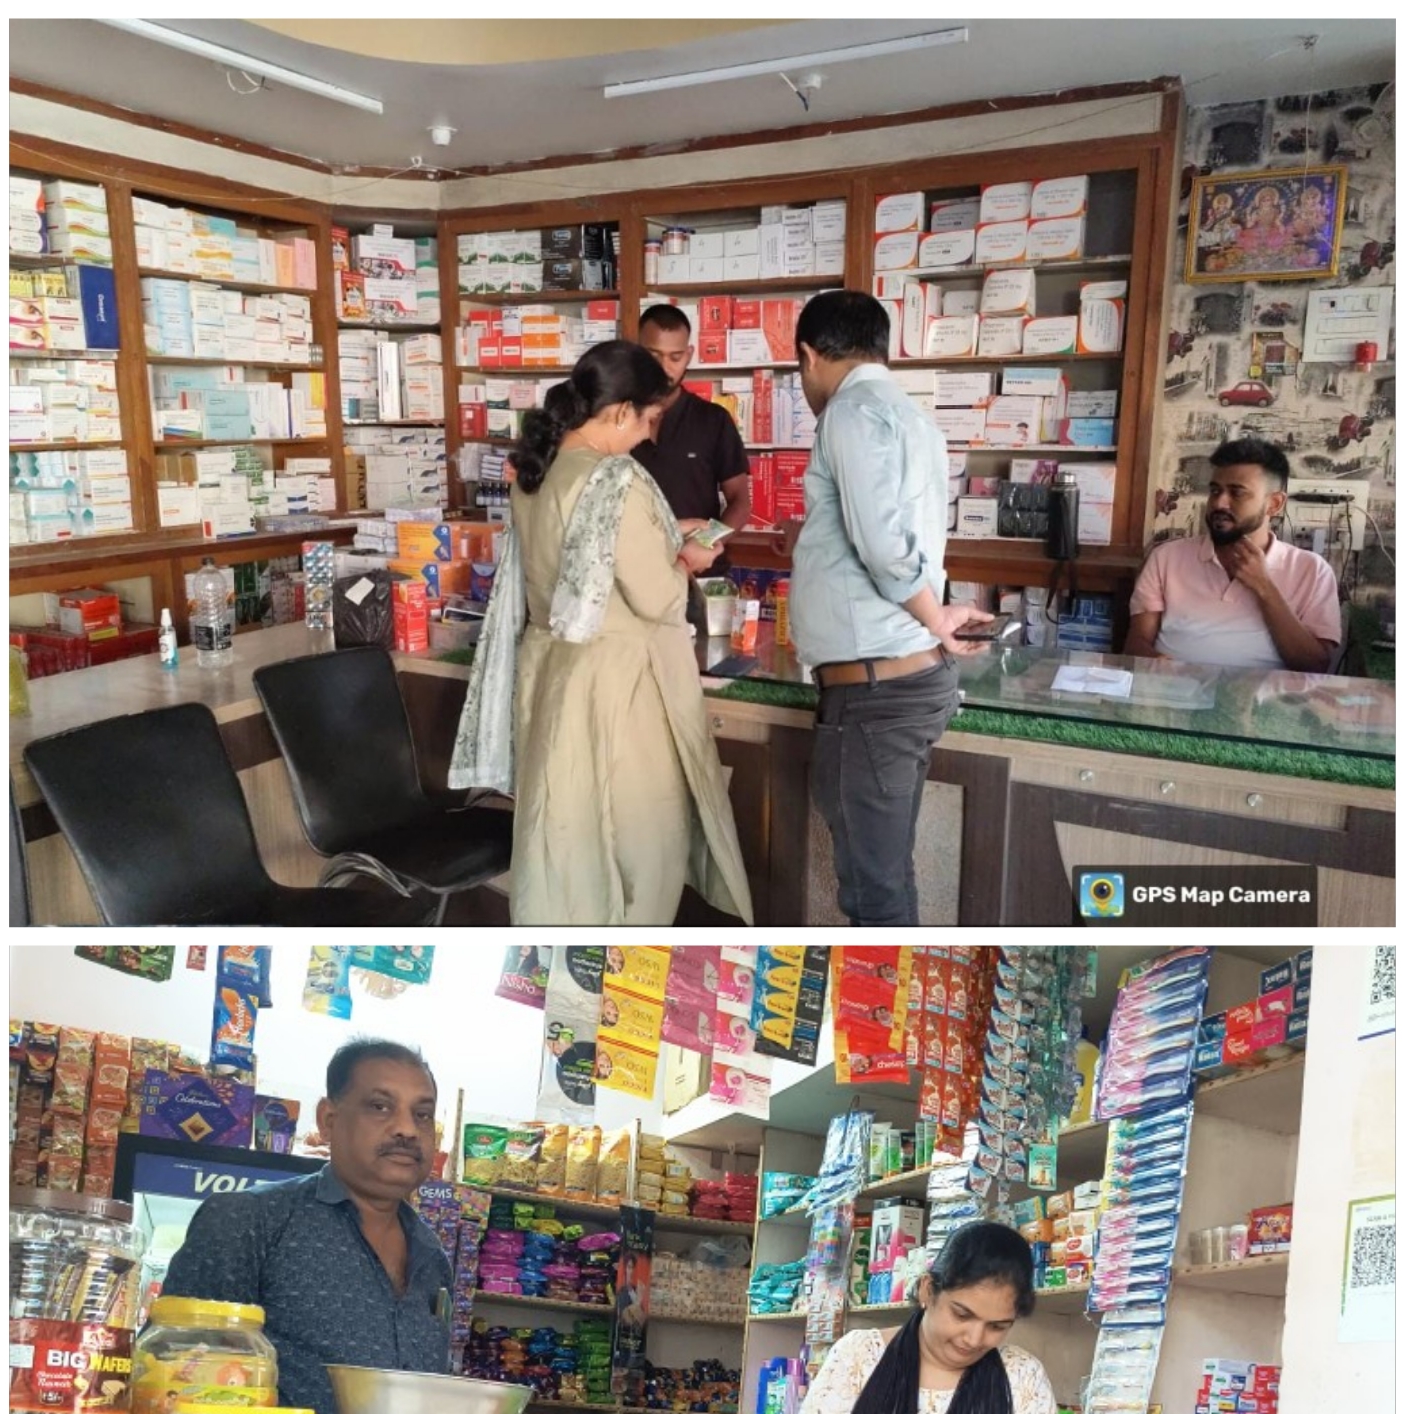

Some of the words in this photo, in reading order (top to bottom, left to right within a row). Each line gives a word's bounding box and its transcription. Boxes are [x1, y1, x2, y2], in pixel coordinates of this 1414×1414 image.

[194, 1171, 270, 1194] VOL
[418, 1184, 453, 1200] GEMS
[47, 1348, 86, 1369] BIG
[89, 1352, 133, 1373] WAFERS
